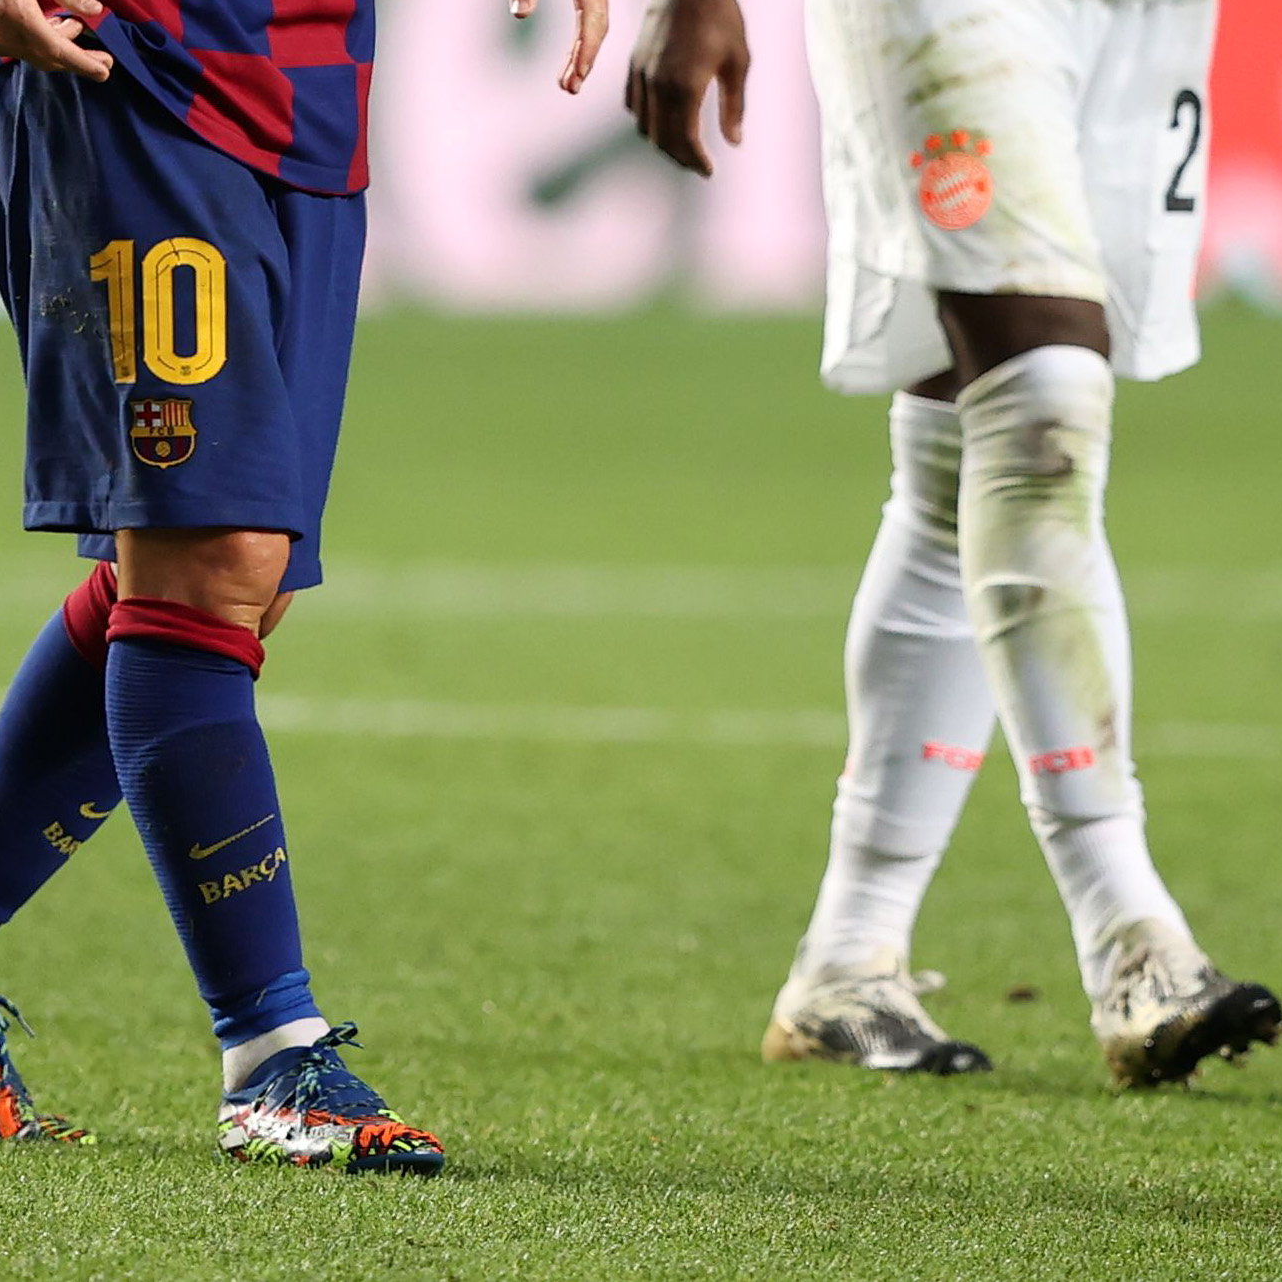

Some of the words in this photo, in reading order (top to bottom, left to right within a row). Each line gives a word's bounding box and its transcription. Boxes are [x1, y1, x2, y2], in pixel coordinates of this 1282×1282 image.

[1165, 89, 1202, 212] 2
[90, 237, 227, 385] 10
[198, 847, 286, 904] BARÇA
